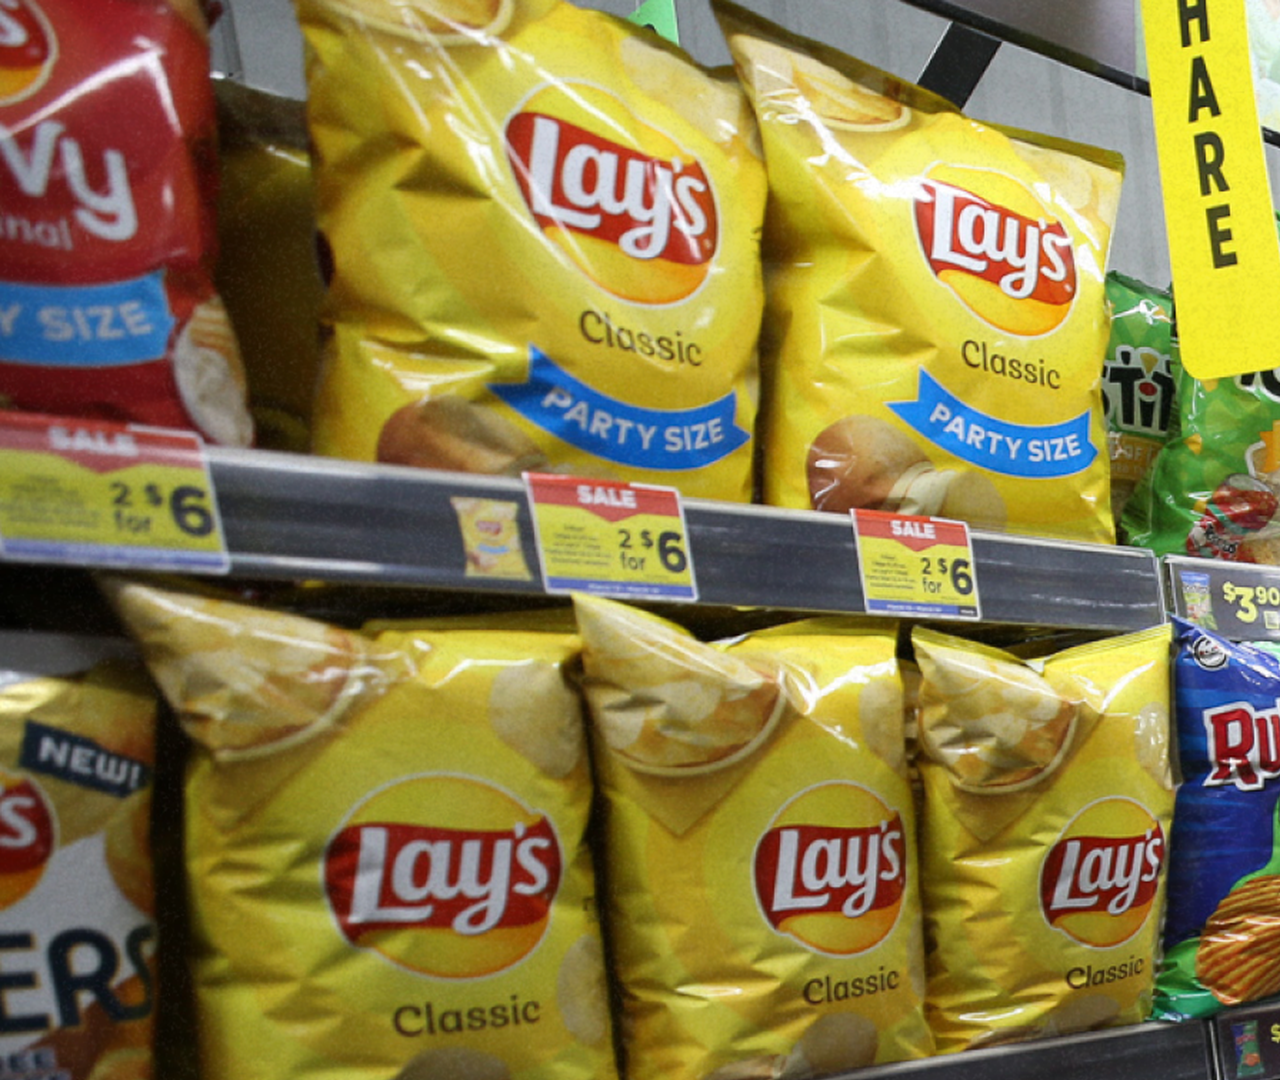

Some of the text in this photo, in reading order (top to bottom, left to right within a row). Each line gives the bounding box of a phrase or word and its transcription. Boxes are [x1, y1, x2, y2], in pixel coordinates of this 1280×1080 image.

[530, 116, 710, 258] Lay's
[930, 182, 1073, 299] Lay's
[38, 305, 153, 342] SIZE
[579, 309, 702, 367] Classic
[961, 340, 1061, 390] Classic
[542, 385, 726, 452] PARTY SIZE
[929, 403, 1021, 459] PARTY
[1029, 431, 1082, 464] SIZE
[49, 428, 138, 457] SALE
[577, 485, 636, 510] SALE
[114, 513, 151, 534] for
[891, 519, 935, 539] SALE
[620, 550, 647, 571] for
[922, 576, 942, 594] for
[38, 734, 142, 790] NEW!
[348, 822, 551, 936] Lay's
[772, 819, 901, 918] Lay's
[1050, 830, 1162, 916] Lay's
[803, 967, 899, 1008] Classic
[1065, 955, 1144, 989] Classic
[393, 996, 541, 1039] Classic
